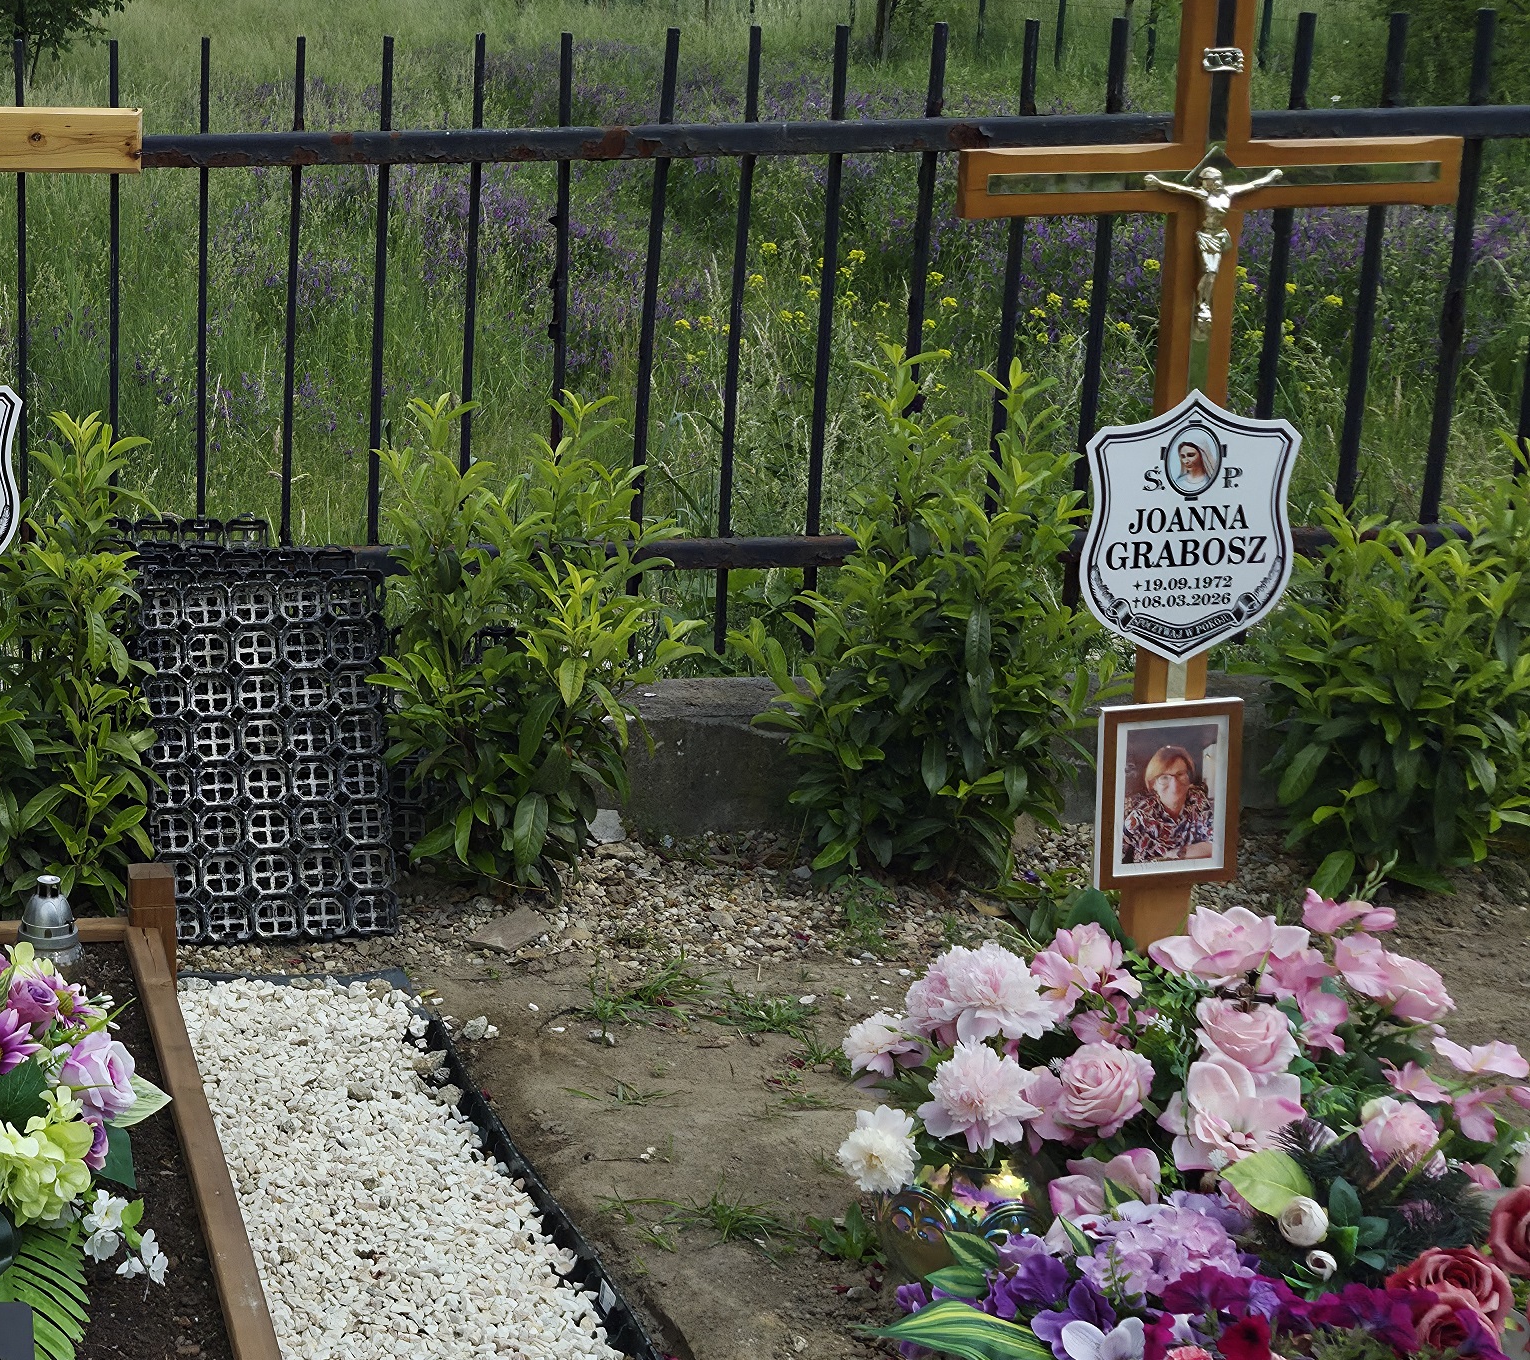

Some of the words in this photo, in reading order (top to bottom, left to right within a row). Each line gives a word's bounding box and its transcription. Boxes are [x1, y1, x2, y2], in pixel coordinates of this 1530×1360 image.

[1142, 465, 1166, 492] Ś.
[1222, 466, 1244, 489] P.
[1128, 504, 1249, 535] JOANNA
[1105, 535, 1268, 571] GRABOSZ
